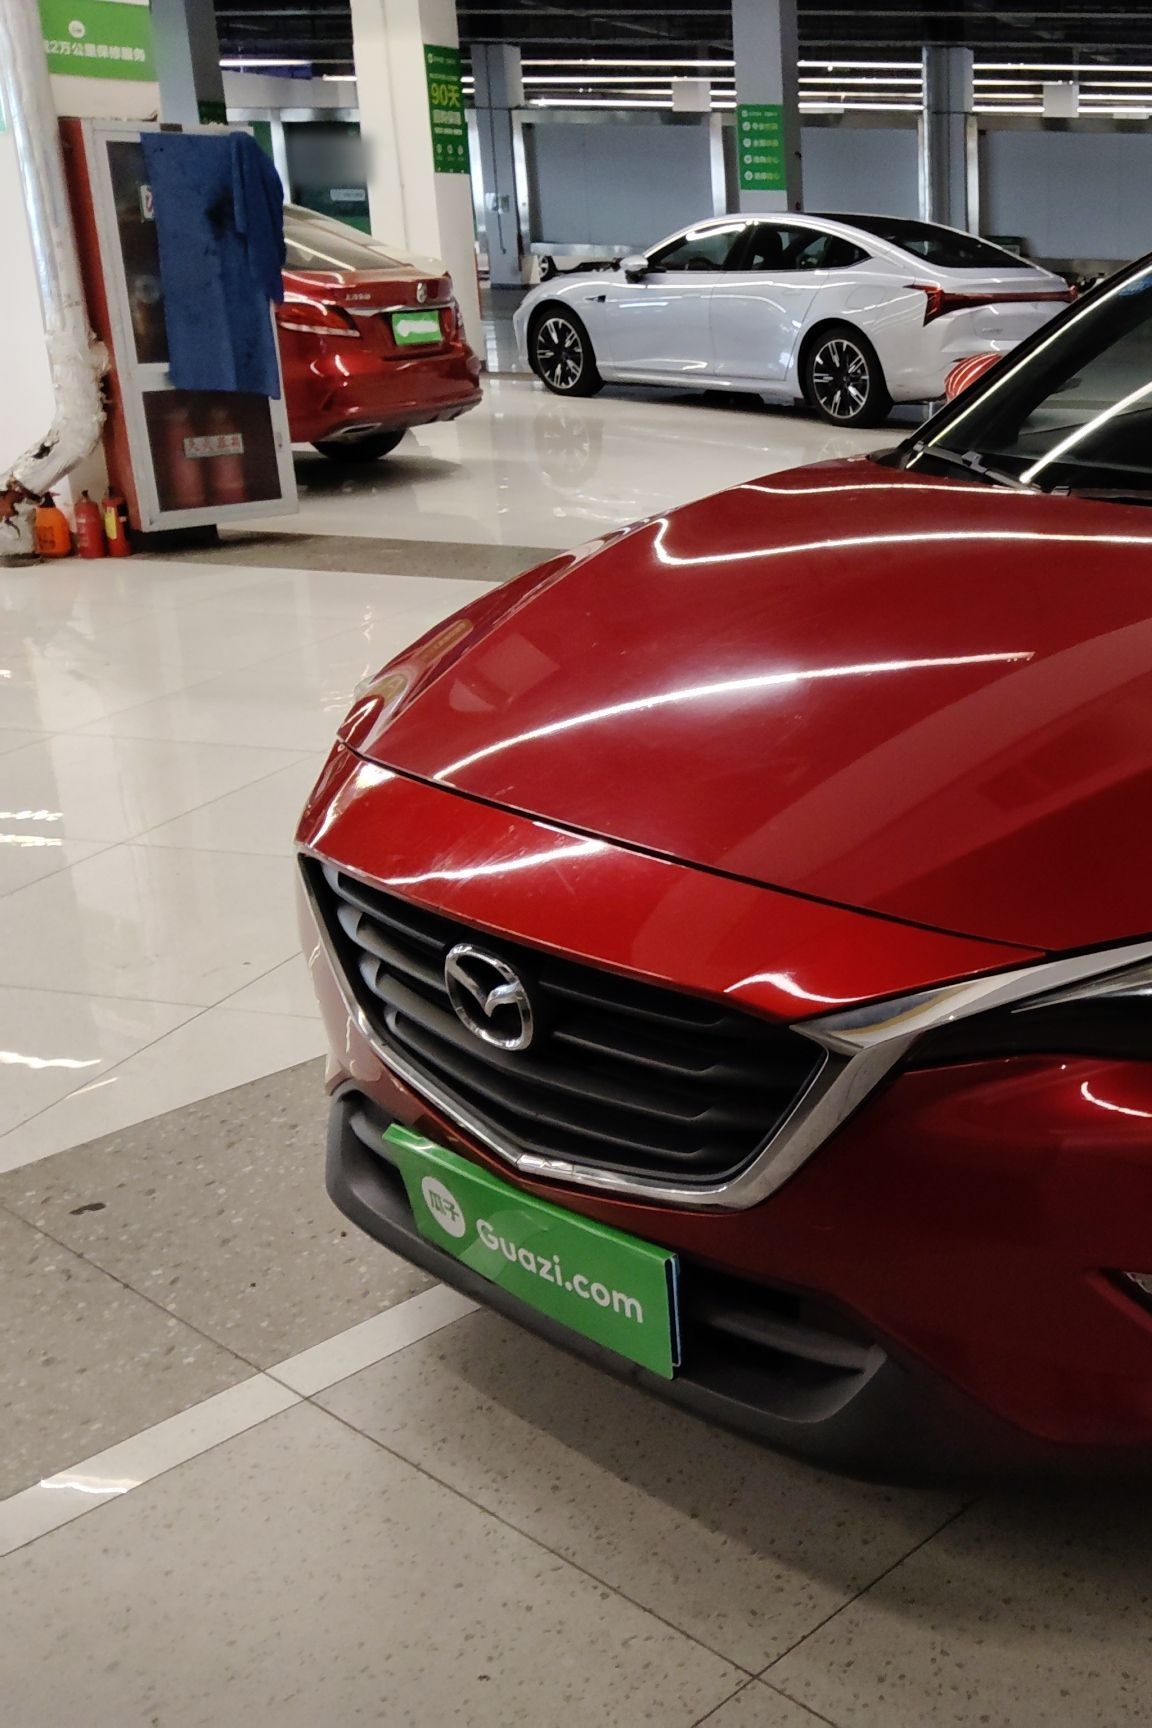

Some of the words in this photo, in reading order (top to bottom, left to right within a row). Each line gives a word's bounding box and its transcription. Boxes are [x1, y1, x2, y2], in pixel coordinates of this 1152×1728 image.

[431, 83, 461, 107] 90天
[428, 1189, 460, 1222] 瓜子
[475, 1217, 644, 1324] Guazi.com
